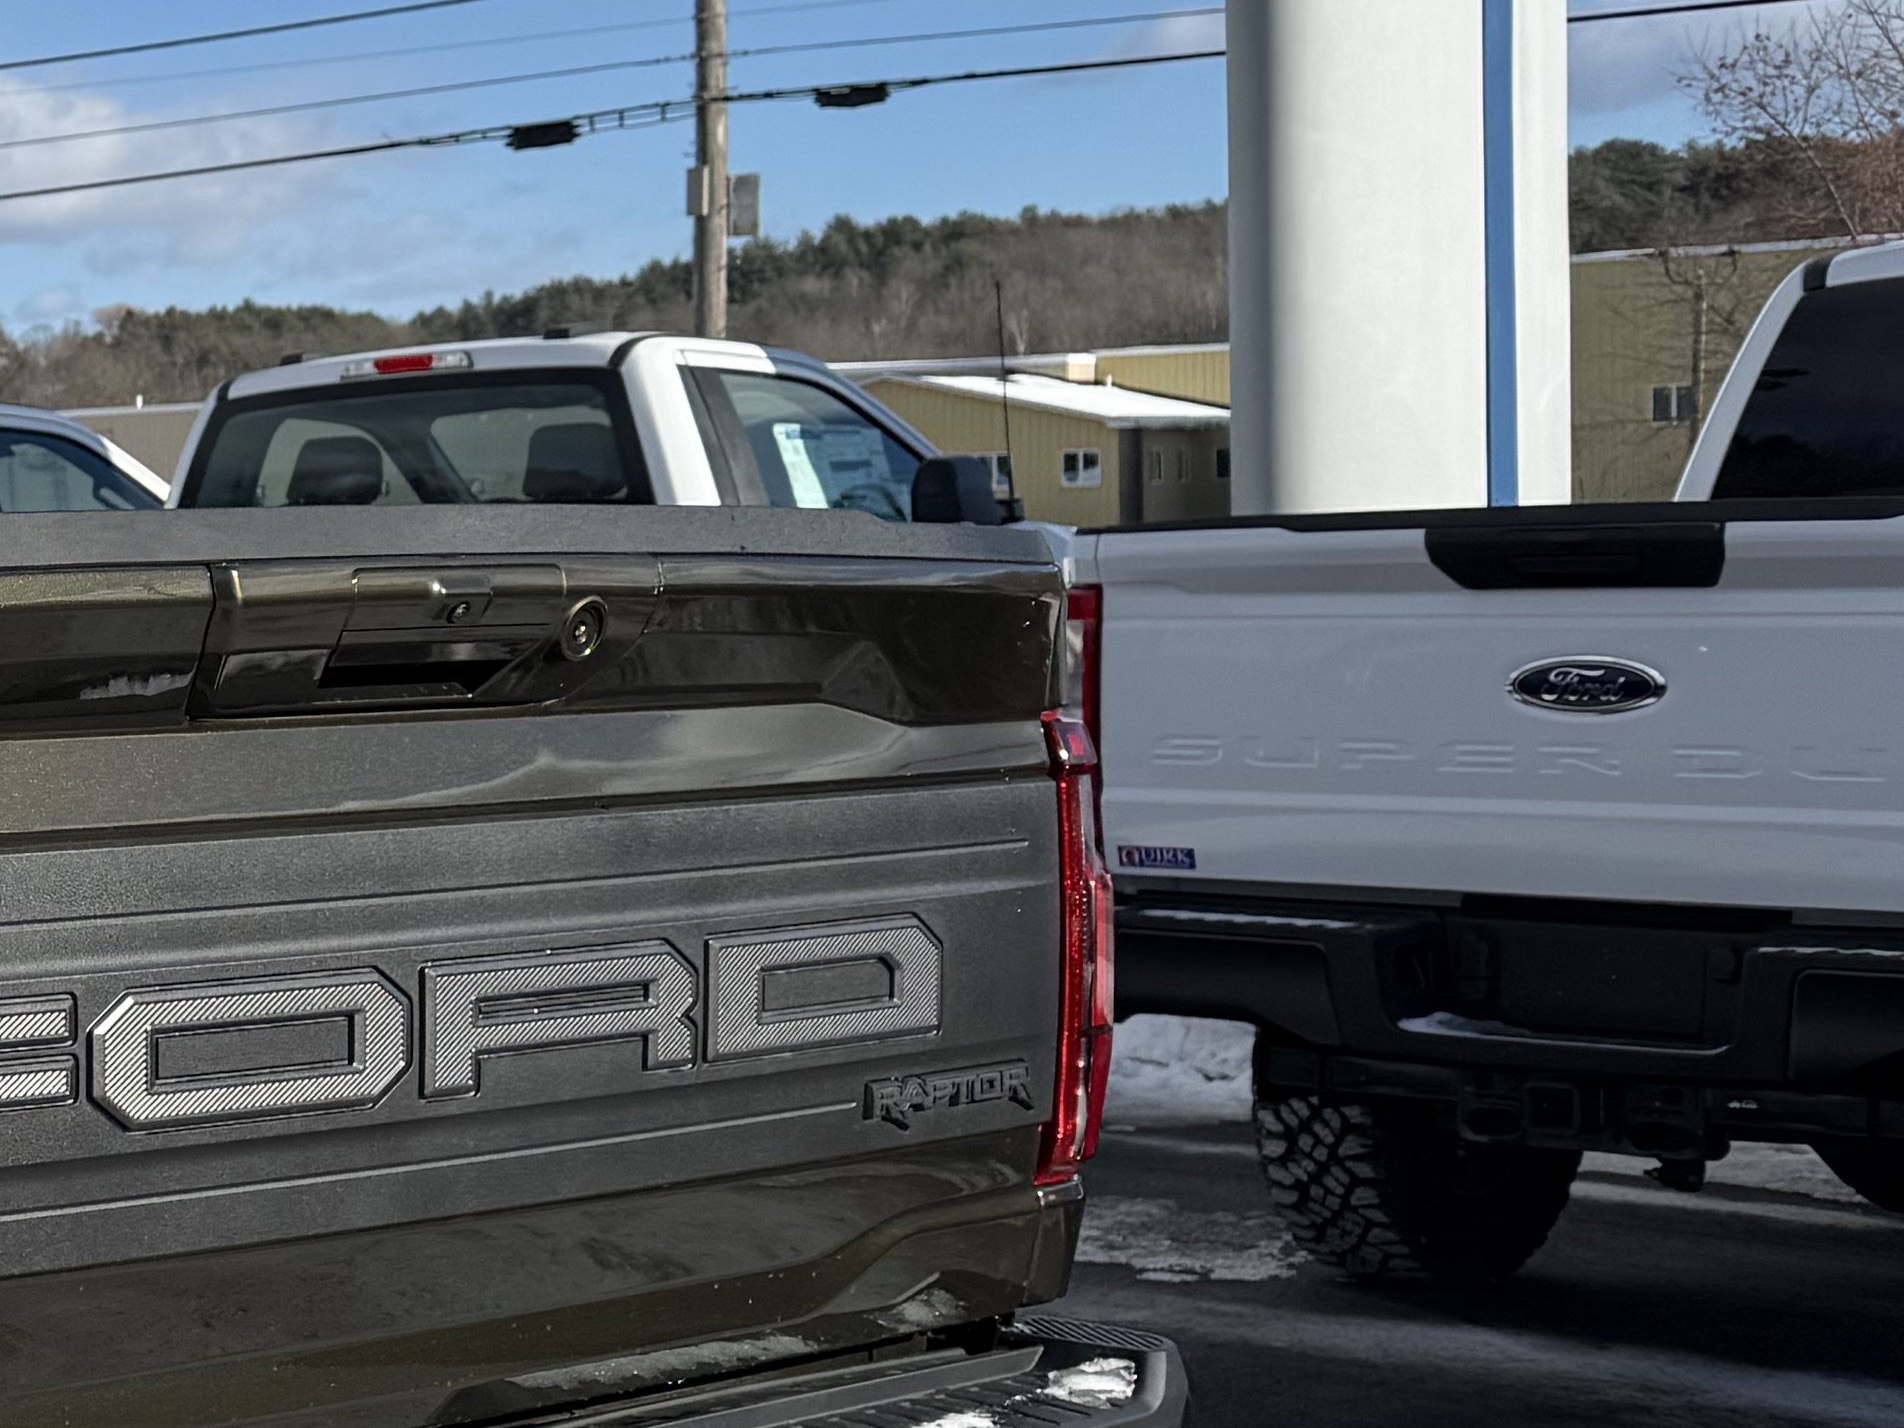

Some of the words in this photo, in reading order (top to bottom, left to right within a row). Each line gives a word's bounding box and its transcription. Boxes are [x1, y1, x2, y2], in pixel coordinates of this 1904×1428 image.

[1540, 666, 1626, 702] Ford
[1152, 734, 1622, 777] SUPER
[861, 1058, 1035, 1134] RAPTOR
